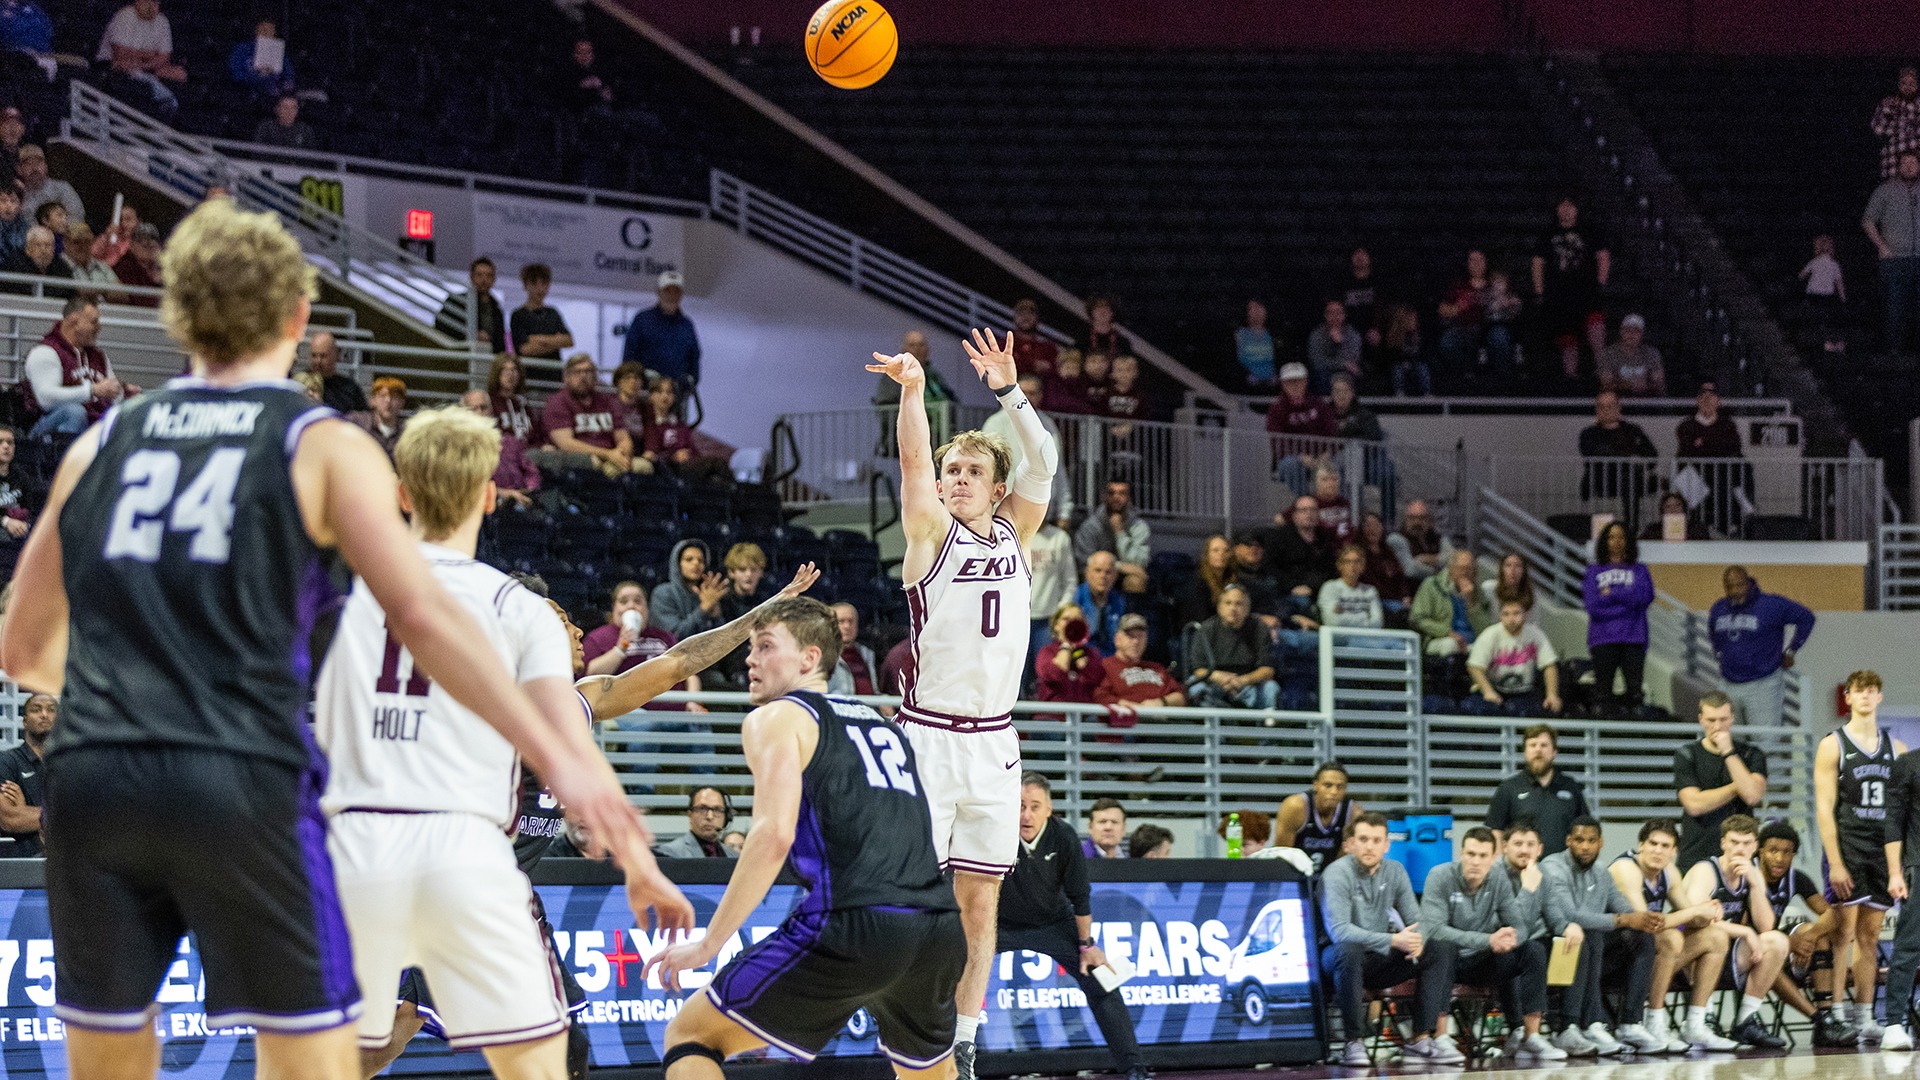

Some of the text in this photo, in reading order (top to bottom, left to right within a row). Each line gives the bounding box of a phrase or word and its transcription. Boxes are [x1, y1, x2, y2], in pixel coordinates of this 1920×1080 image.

[831, 5, 868, 41] NCAA
[407, 208, 434, 239] EXIT
[594, 251, 641, 275] Central
[103, 446, 248, 565] 24
[957, 554, 1017, 577] EKU
[981, 589, 1001, 638] 0
[372, 706, 426, 741] HOLT
[845, 724, 917, 797] 12
[1860, 780, 1885, 807] 13
[996, 988, 1016, 1010] OF
[1120, 984, 1223, 1006] EXCELLENCE
